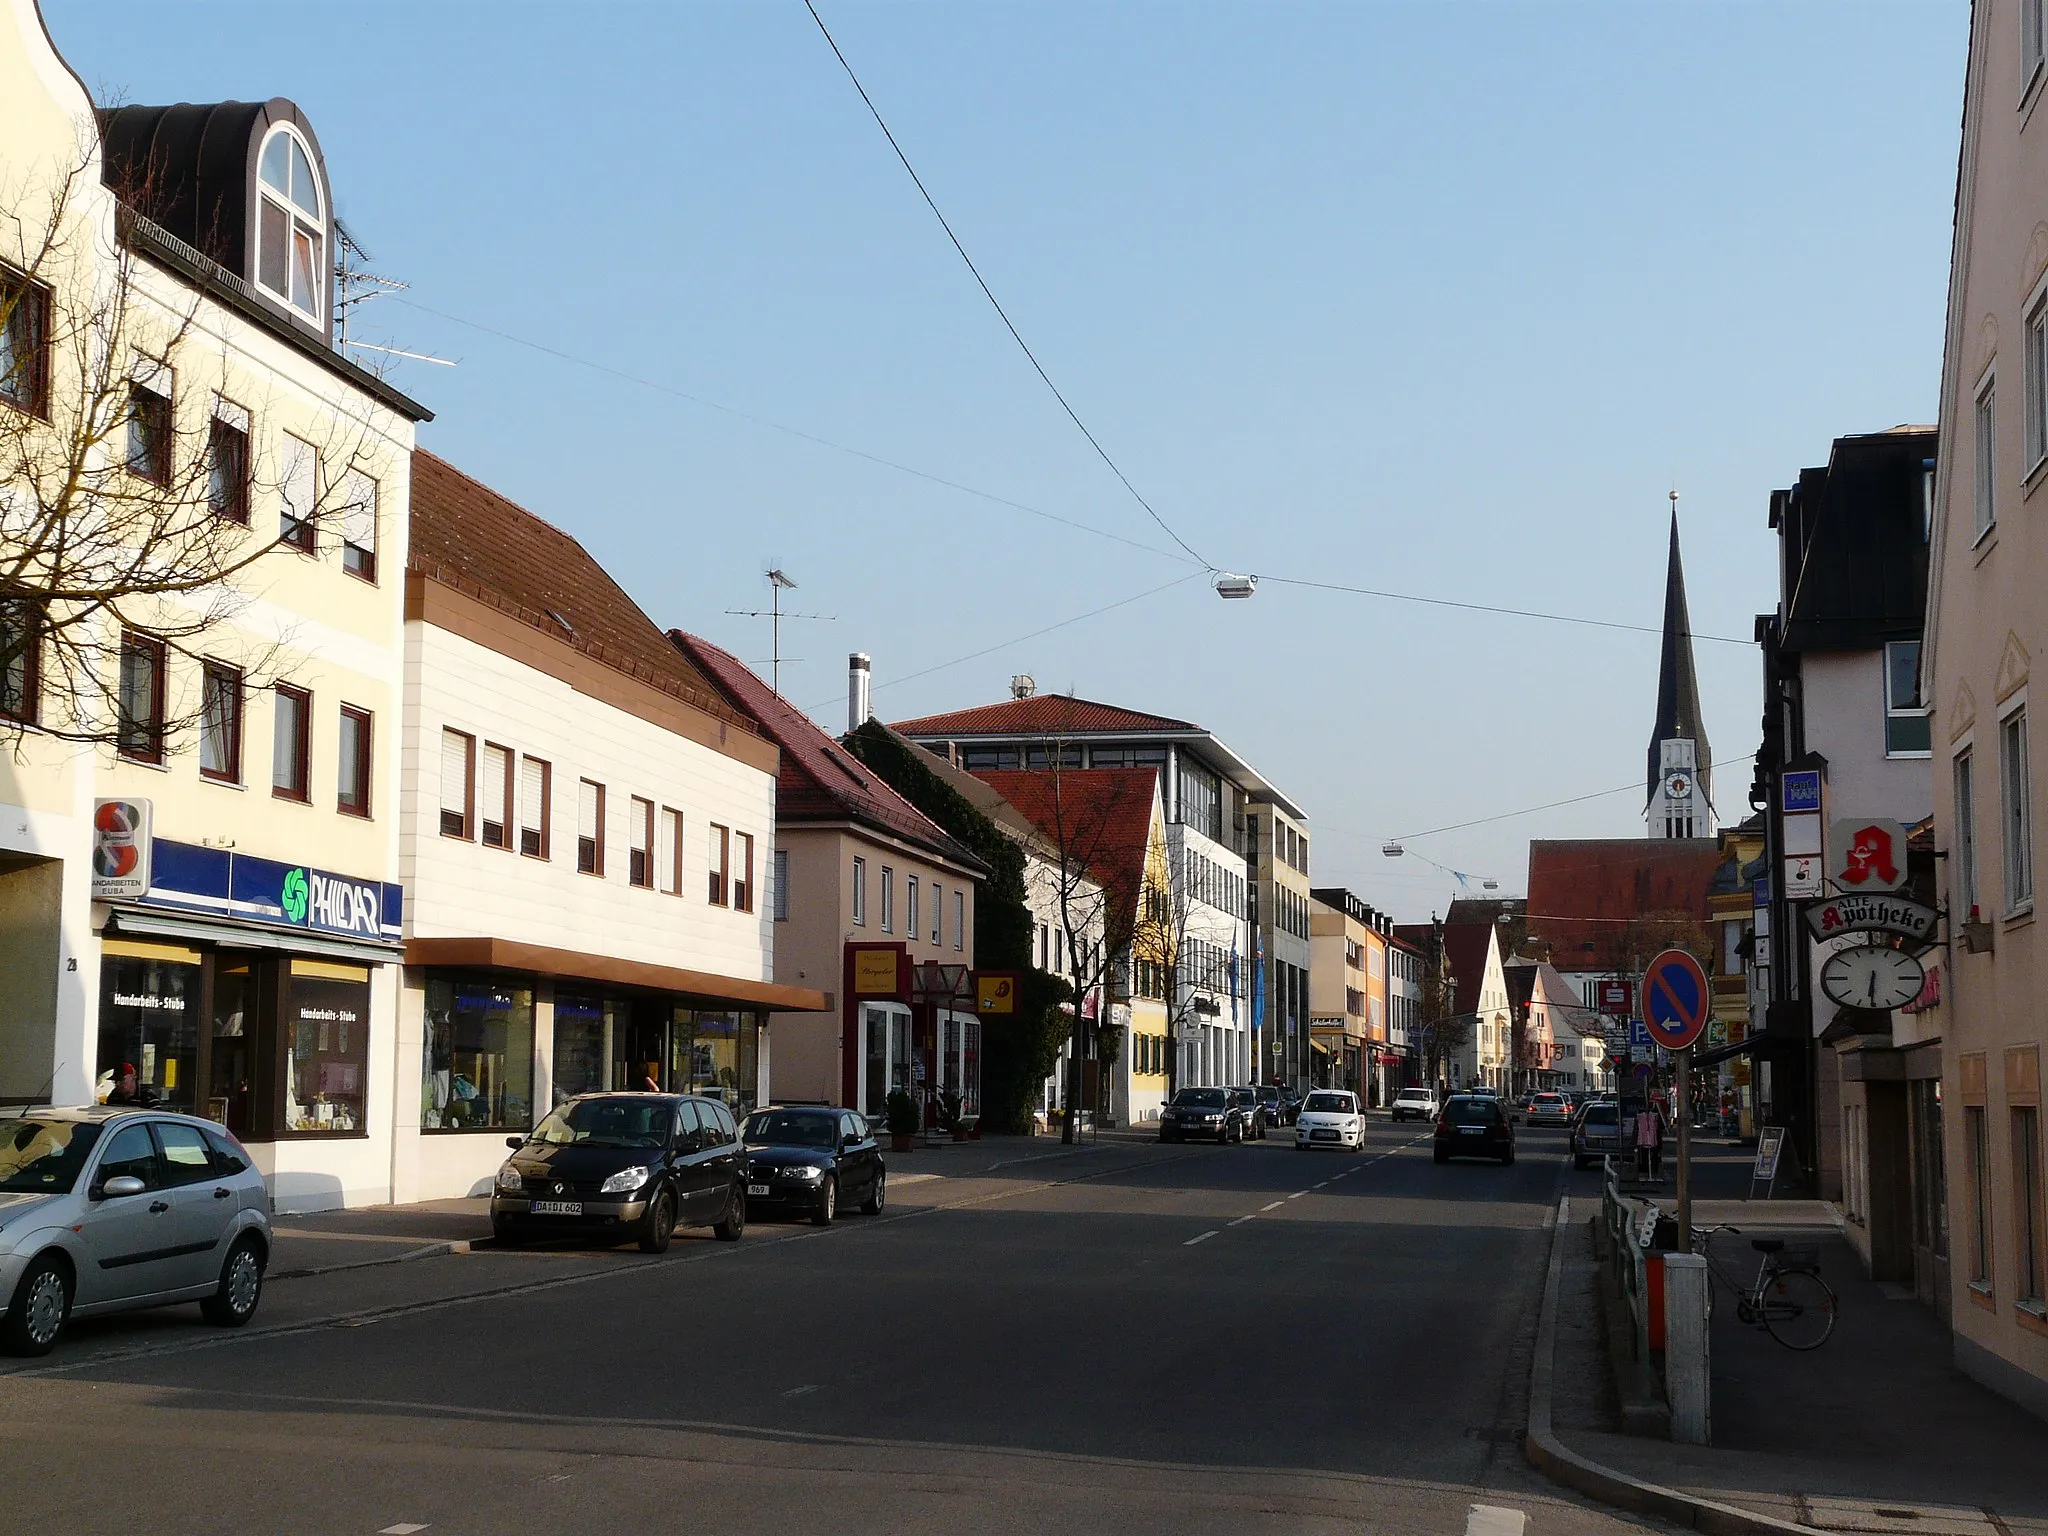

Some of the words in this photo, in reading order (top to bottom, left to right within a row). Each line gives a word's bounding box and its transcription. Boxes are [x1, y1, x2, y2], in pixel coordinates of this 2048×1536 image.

[102, 887, 124, 895] EUBA
[310, 874, 380, 935] PHILDAR
[1838, 897, 1869, 910] ALTE
[1822, 902, 1925, 931] Apotheke
[565, 1203, 581, 1213] 602
